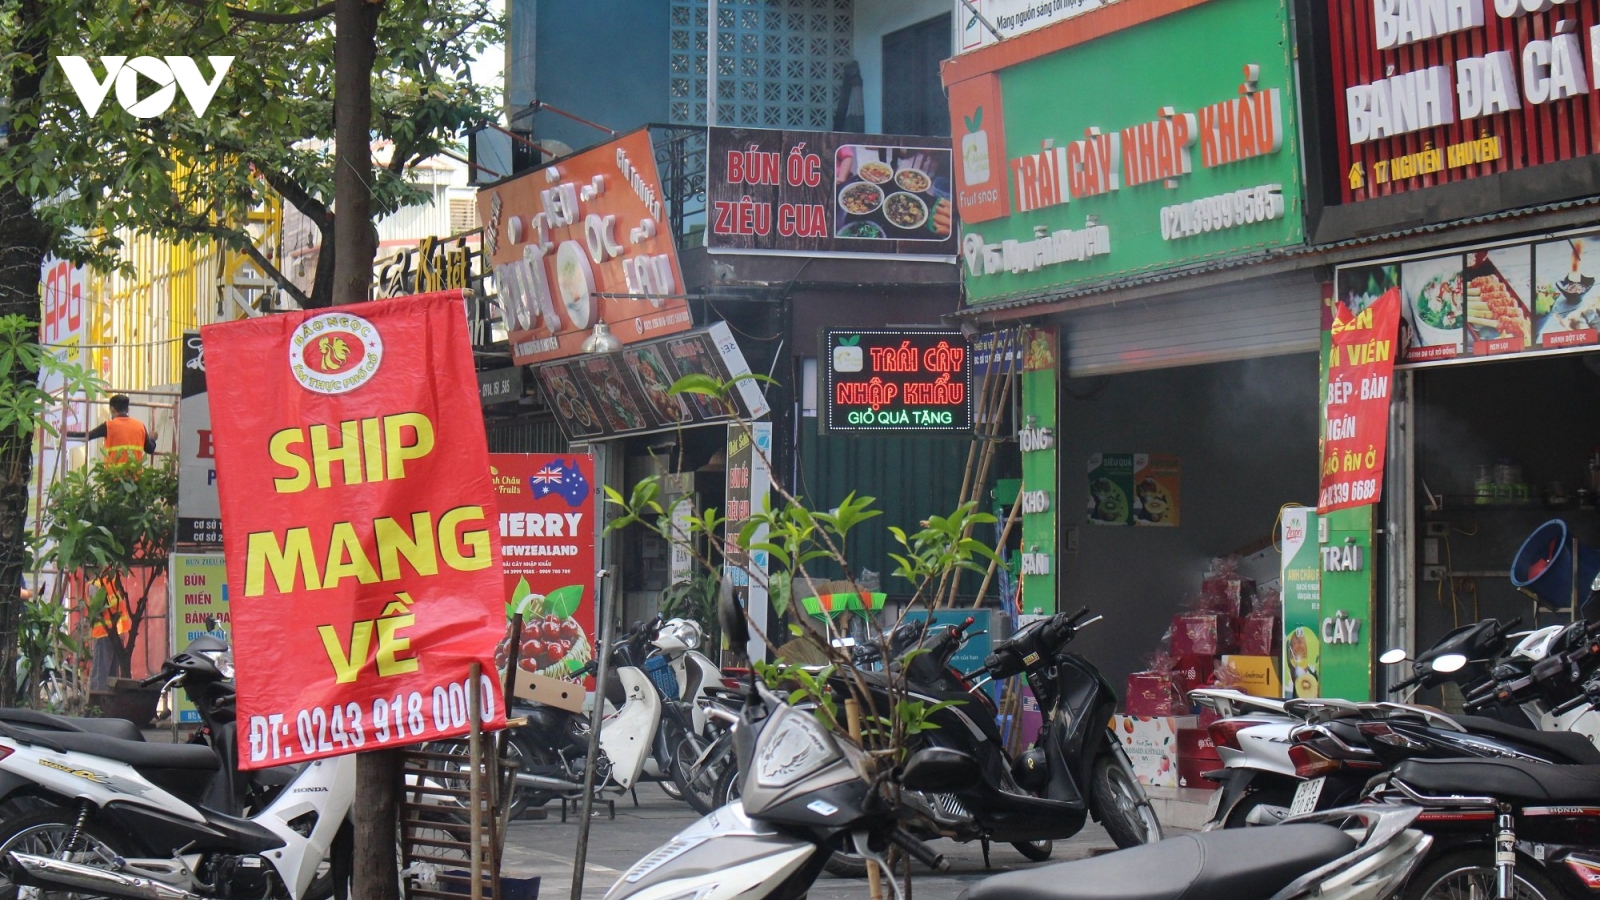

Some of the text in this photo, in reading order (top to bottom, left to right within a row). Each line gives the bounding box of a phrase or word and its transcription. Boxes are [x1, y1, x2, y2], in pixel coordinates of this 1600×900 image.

[996, 15, 1015, 31] Mang
[1346, 64, 1454, 145] BÁNH
[1456, 50, 1521, 120] ĐA
[1522, 19, 1589, 105] CÁ
[1010, 64, 1284, 212] TRÁI CÂY NHẬP KHẨU
[727, 142, 821, 188] BÚN ỐC
[1373, 129, 1502, 184] 17 NGUYỄN KHUYẾN
[714, 195, 828, 238] ZIÊU CUA
[44, 261, 81, 341] APG
[326, 317, 371, 338] NGỌC
[1566, 335, 1576, 344] BỘT
[1577, 333, 1587, 343] LỌC
[870, 341, 963, 372] TRÁI CÂY
[1346, 339, 1391, 366] VIÊN
[836, 373, 963, 411] NHẬP KHẨU
[1327, 374, 1388, 405] BẾP BÀN
[848, 408, 953, 426] GIỎ QUÀ TẶNG
[1018, 415, 1054, 452] TỔNG
[268, 412, 435, 493] SHIP
[1365, 444, 1376, 470] Ở
[498, 485, 521, 494] Fruits
[500, 475, 521, 485] Châu
[1351, 479, 1376, 501] 6688
[1022, 490, 1050, 514] KHO
[193, 521, 204, 529] CƠ
[206, 519, 217, 530] SỞ
[193, 533, 204, 541] CƠ
[206, 531, 217, 541] SỞ
[244, 506, 493, 598] MANG
[1320, 536, 1363, 572] TRÁI
[184, 573, 206, 586] BÚN
[185, 591, 212, 605] MIẾN
[316, 592, 419, 684] VỀ
[1322, 609, 1361, 644] CÂY
[248, 714, 293, 763] ĐT:
[296, 702, 365, 756] 0243
[371, 692, 424, 745] 918
[1550, 806, 1584, 814] HONDA
